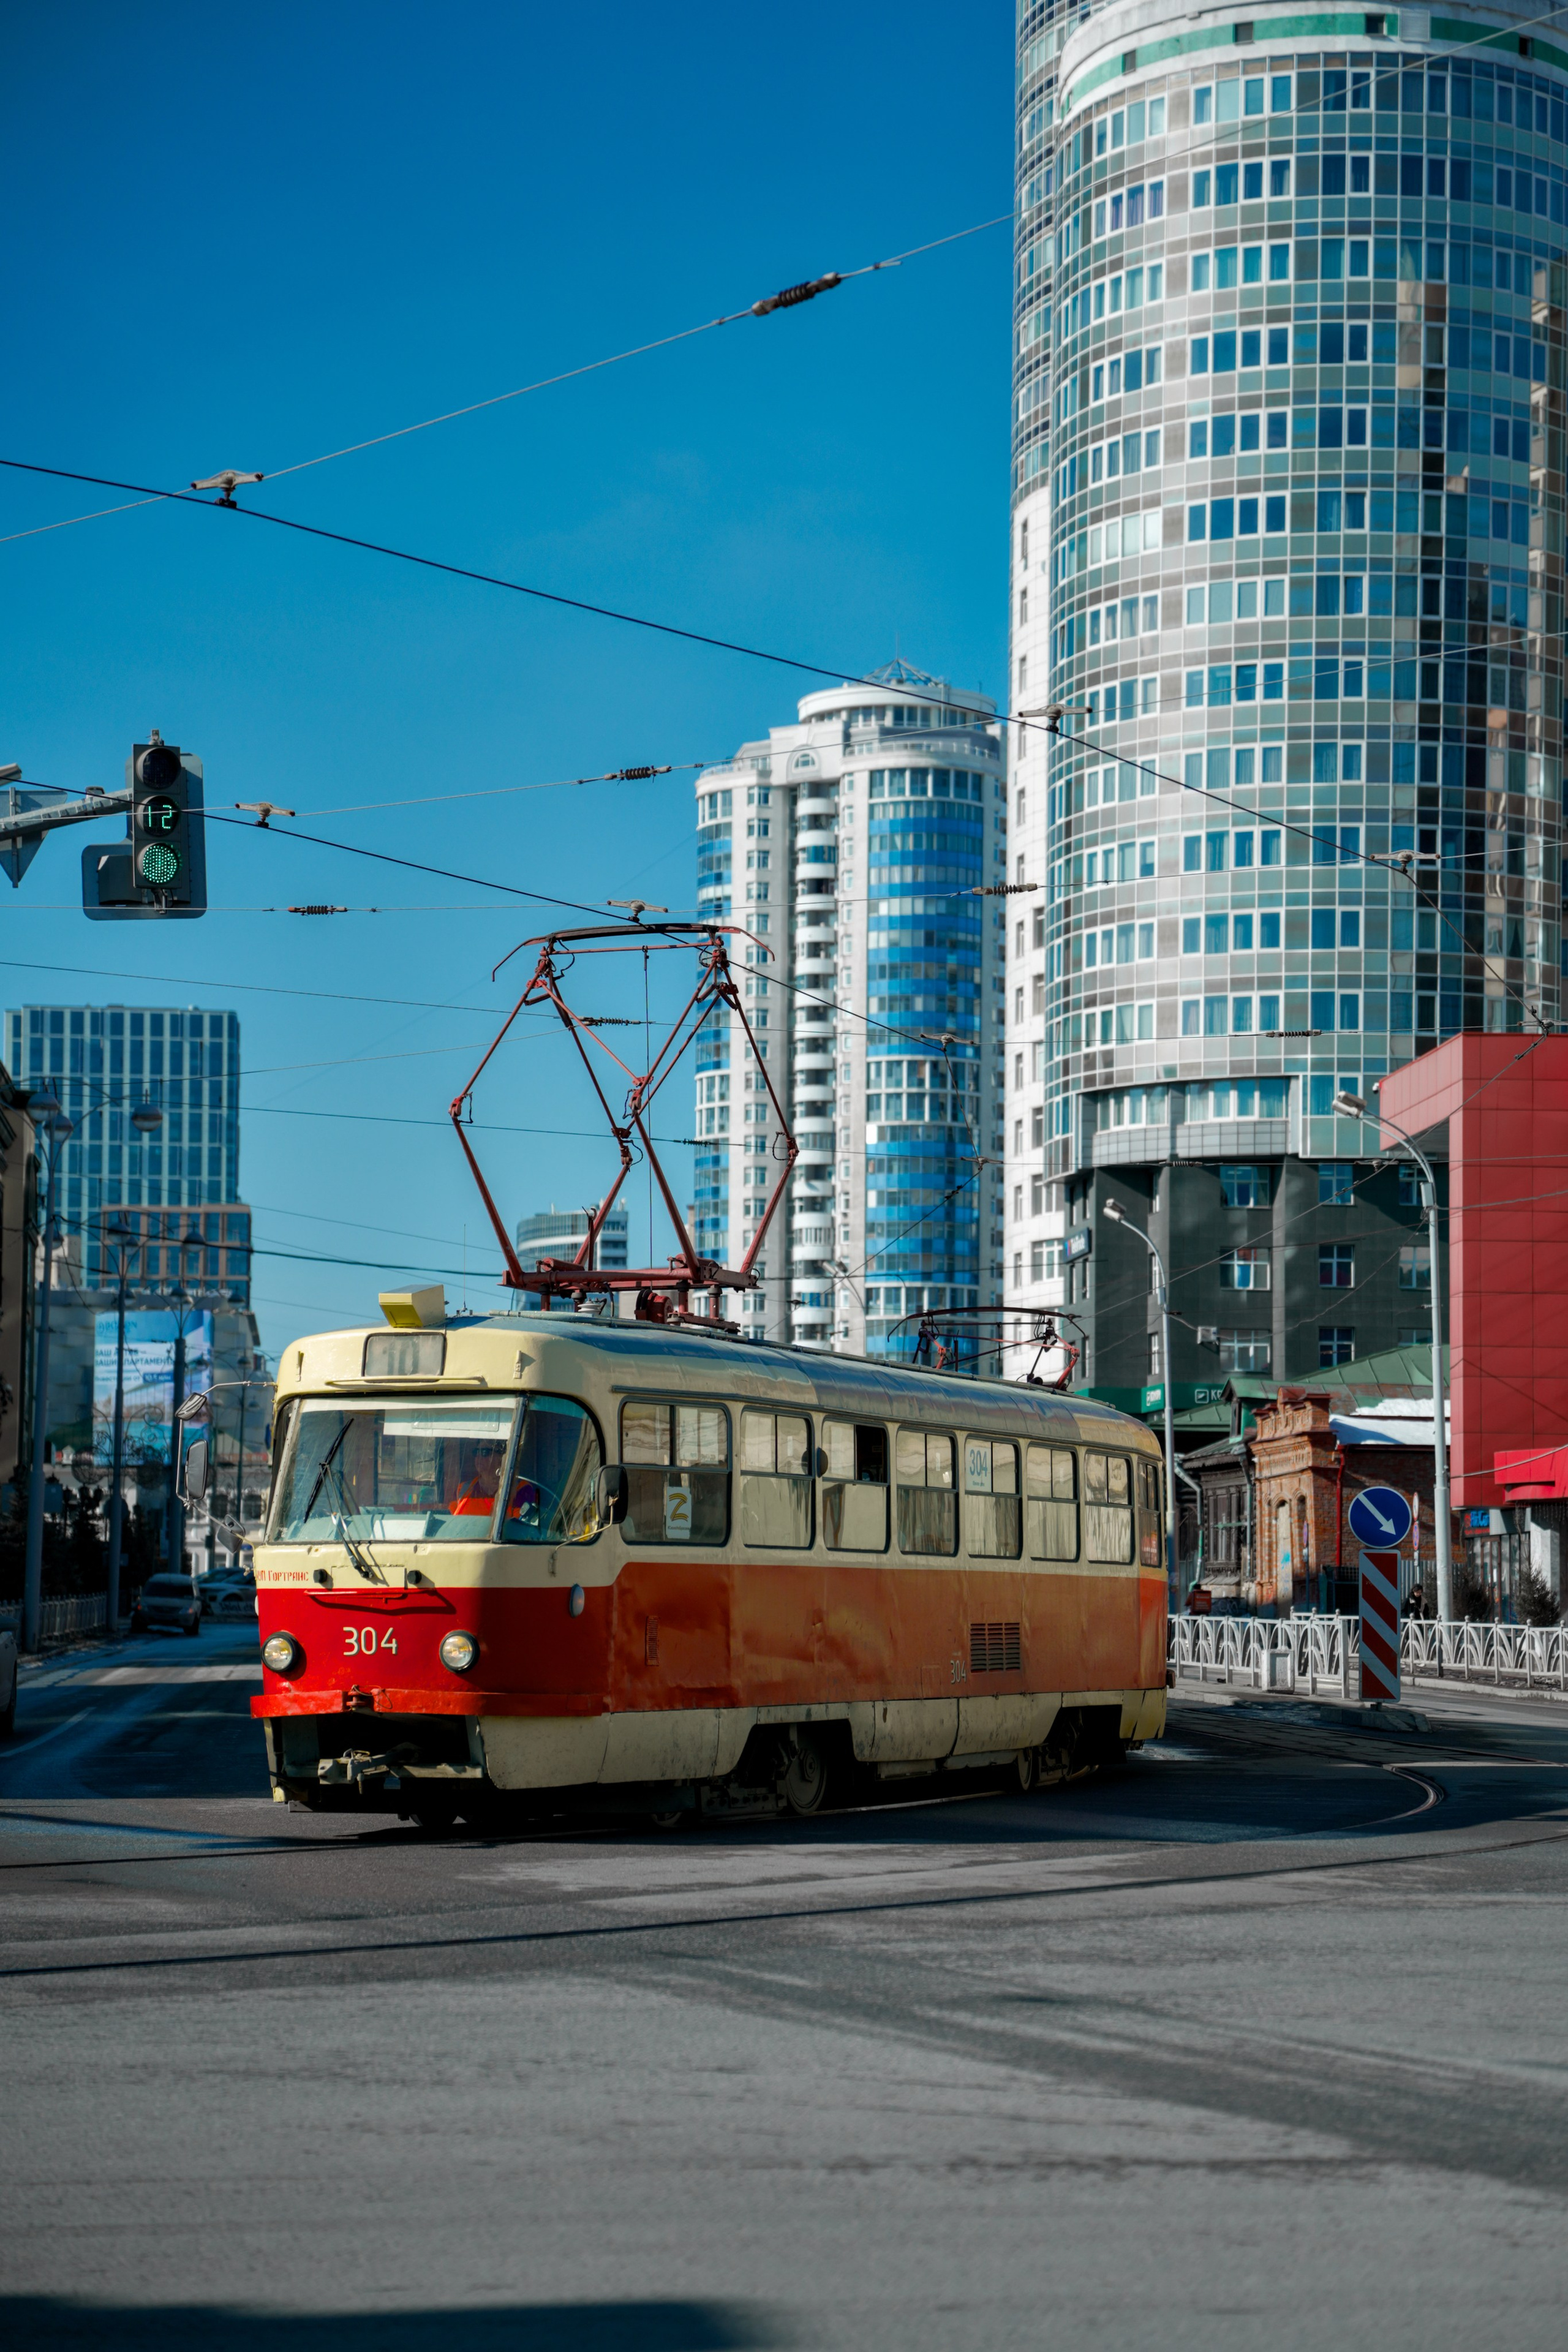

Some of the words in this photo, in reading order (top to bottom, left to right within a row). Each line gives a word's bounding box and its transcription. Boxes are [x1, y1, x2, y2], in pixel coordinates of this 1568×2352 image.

[148, 805, 172, 829] 12
[970, 1449, 987, 1477] 304
[343, 1626, 398, 1656] 304
[950, 1660, 967, 1684] 304
